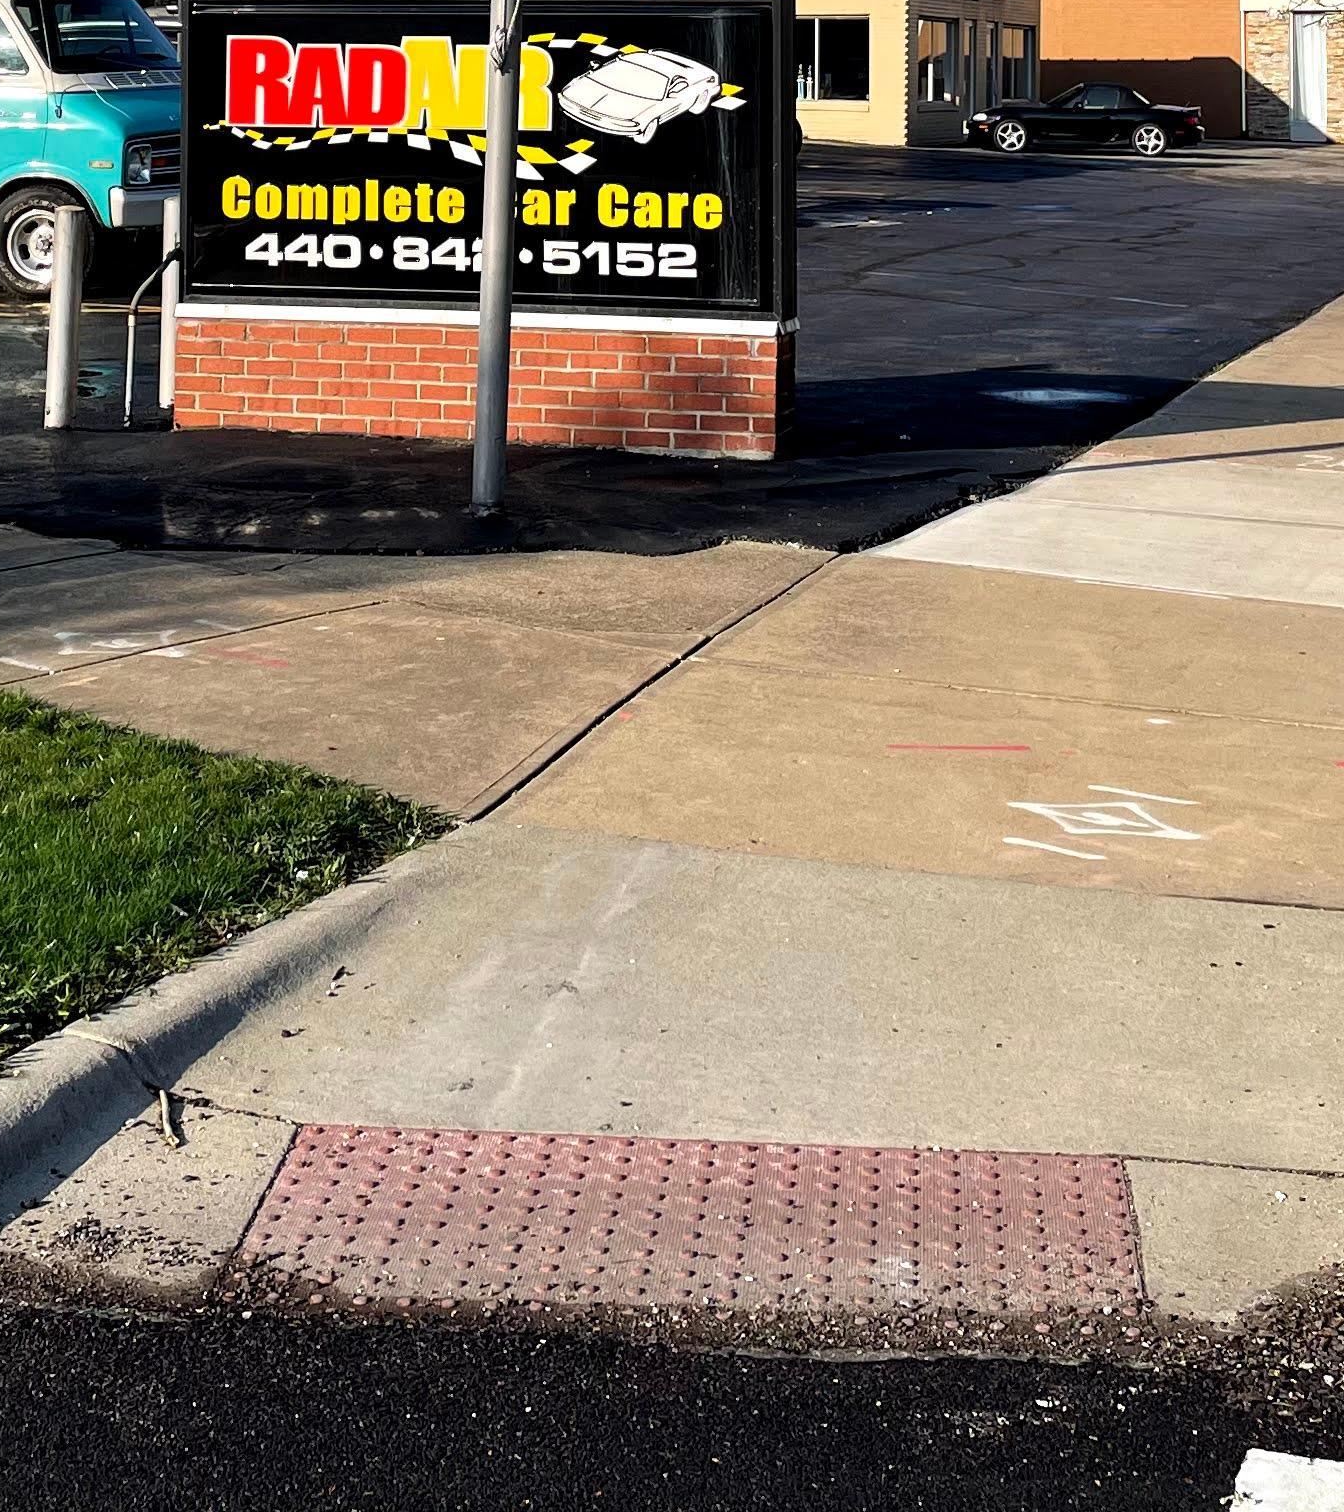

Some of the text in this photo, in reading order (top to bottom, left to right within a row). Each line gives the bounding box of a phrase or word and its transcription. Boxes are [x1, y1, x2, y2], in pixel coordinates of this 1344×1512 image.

[222, 175, 723, 230] Complete ar Care
